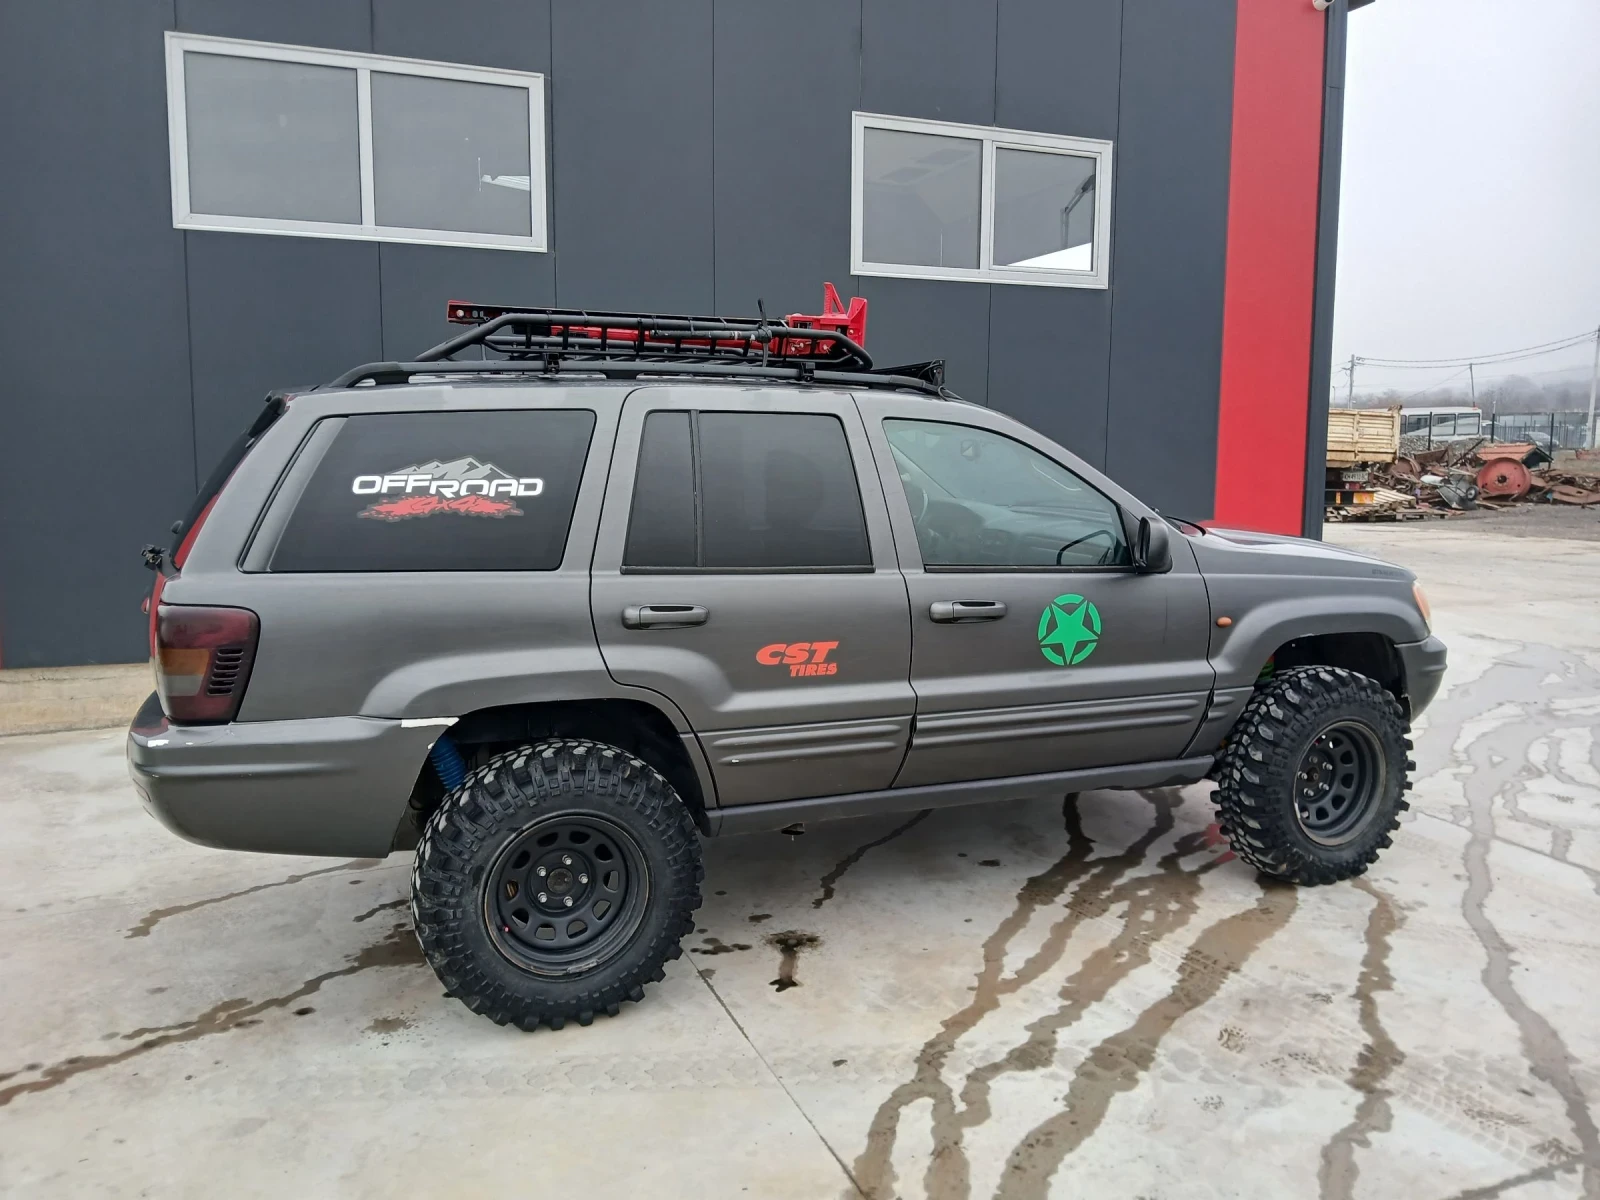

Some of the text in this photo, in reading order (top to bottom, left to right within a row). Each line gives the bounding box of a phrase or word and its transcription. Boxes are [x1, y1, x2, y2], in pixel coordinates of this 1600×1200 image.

[352, 473, 544, 498] OFFROAD
[755, 641, 839, 666] CST
[789, 662, 838, 677] TIRES
